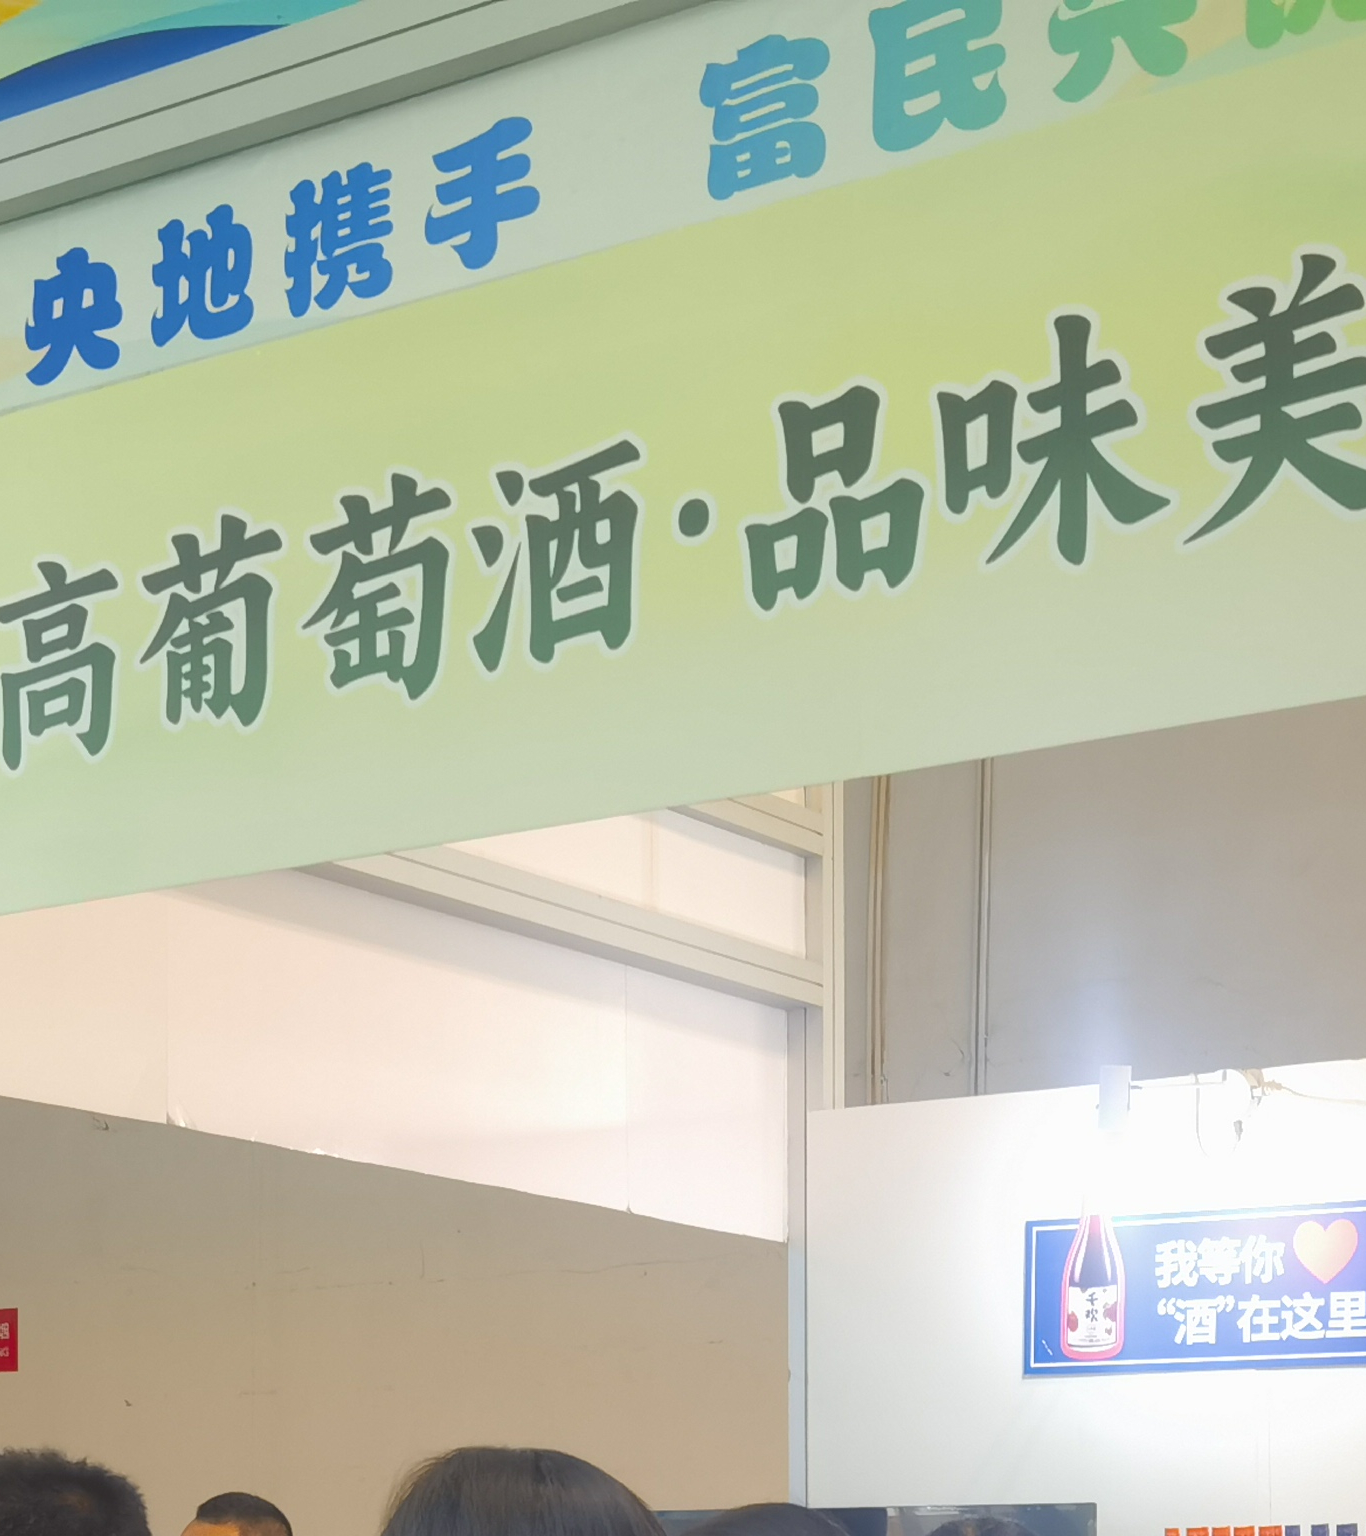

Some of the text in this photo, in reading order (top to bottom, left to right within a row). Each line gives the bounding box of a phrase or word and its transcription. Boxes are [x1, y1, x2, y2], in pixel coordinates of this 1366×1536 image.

[23, 114, 542, 386] 央地携手
[1155, 1234, 1286, 1287] 我等你
